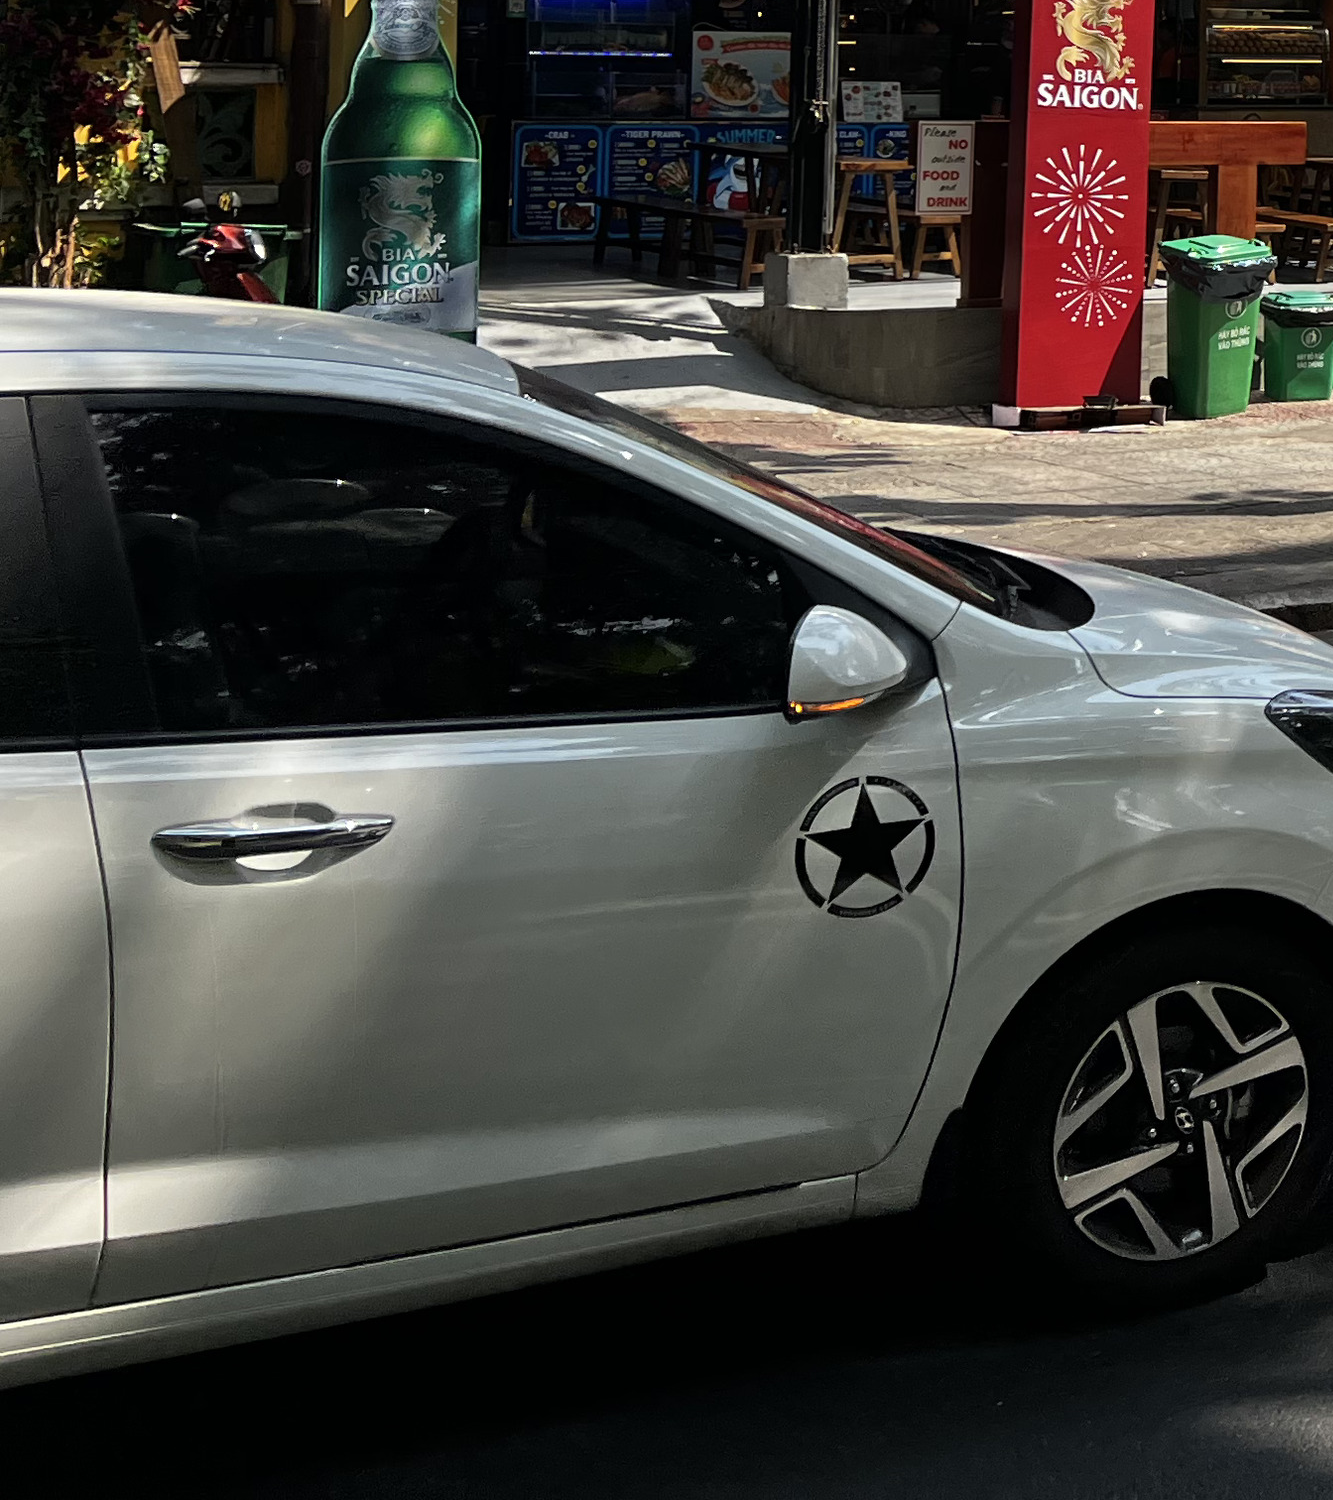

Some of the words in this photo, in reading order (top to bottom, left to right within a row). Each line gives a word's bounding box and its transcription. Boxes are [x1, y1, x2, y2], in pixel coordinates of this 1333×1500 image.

[1074, 68, 1105, 84] BIA
[1037, 83, 1139, 110] SAIGON
[625, 130, 650, 139] TIGER
[651, 130, 682, 139] PRAWN
[716, 129, 776, 144] SUMMER
[924, 127, 957, 137] Please
[949, 139, 968, 150] NO
[931, 154, 966, 164] outside
[923, 170, 960, 181] FOOD
[939, 183, 957, 192] and
[927, 196, 967, 208] DRINK
[382, 248, 416, 262] BIA
[346, 262, 451, 287] SAIGON
[355, 286, 445, 306] SPECIAL
